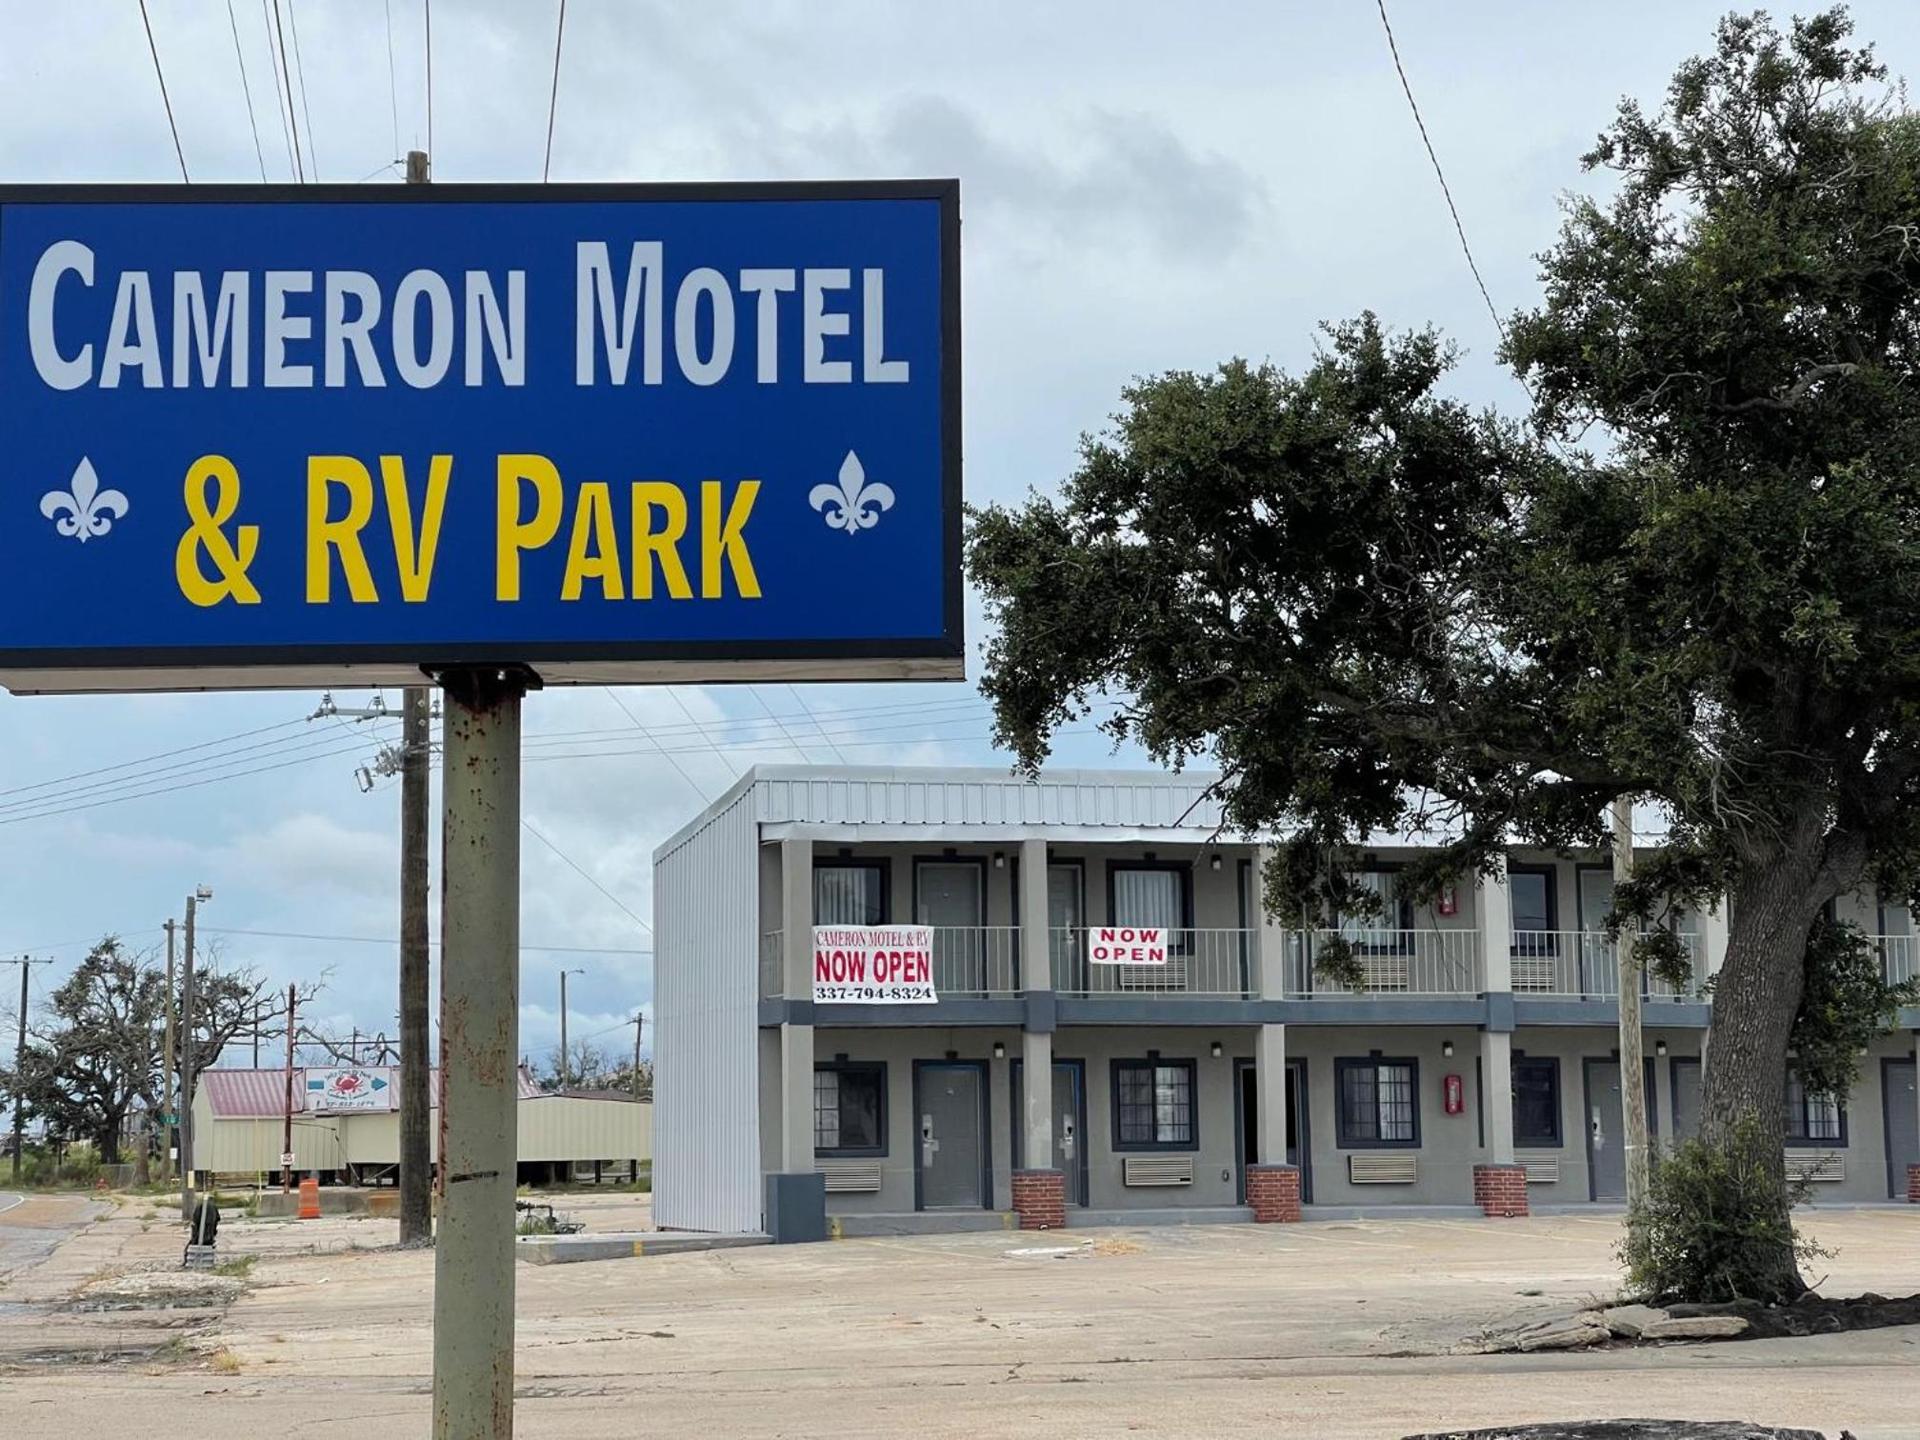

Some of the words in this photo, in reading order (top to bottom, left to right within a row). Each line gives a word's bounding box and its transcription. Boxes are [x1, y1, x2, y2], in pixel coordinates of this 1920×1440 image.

[28, 240, 526, 391] CAMERON
[576, 241, 909, 386] MOTEL
[175, 454, 262, 607] &
[306, 454, 454, 604] RV
[496, 454, 762, 601] PARK
[816, 931, 866, 947] CAMERON
[869, 931, 905, 947] MOTEL
[906, 931, 914, 946] &
[916, 931, 930, 946] RV
[1101, 929, 1158, 943] NOW
[1093, 947, 1163, 961] OPEN
[816, 950, 866, 982] NOW
[873, 950, 929, 983] OPEN
[816, 987, 932, 1000] 337-794-8324
